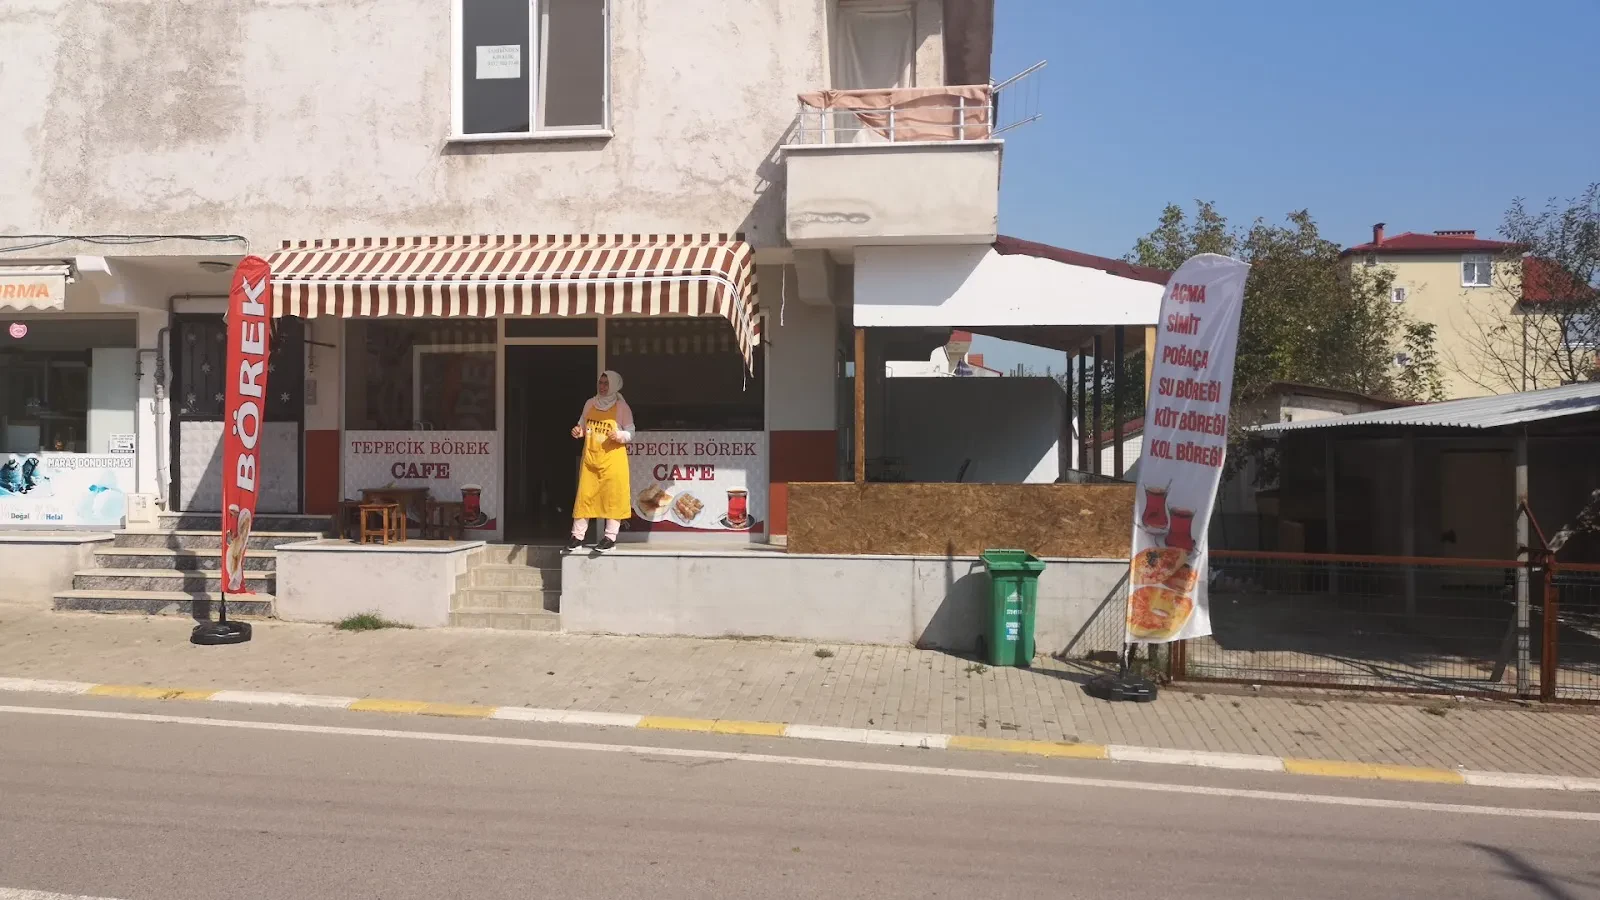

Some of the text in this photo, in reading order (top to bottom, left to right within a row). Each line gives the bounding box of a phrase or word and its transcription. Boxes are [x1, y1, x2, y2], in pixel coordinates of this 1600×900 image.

[0, 284, 49, 298] RMA
[1170, 283, 1206, 304] AÇMA
[1167, 312, 1201, 335] SİMİT
[1162, 344, 1209, 371] POĞAÇA
[232, 276, 266, 493] BÖREK
[1158, 377, 1175, 396] SU
[1154, 406, 1180, 429] KÜT
[351, 438, 490, 455] TEPECİK BÖREK
[625, 438, 757, 456] EPECİK BÖREK
[1150, 438, 1173, 460] KOL
[47, 457, 77, 470] MARAŞ
[391, 462, 450, 479] CAFE
[653, 463, 715, 481] CAFE
